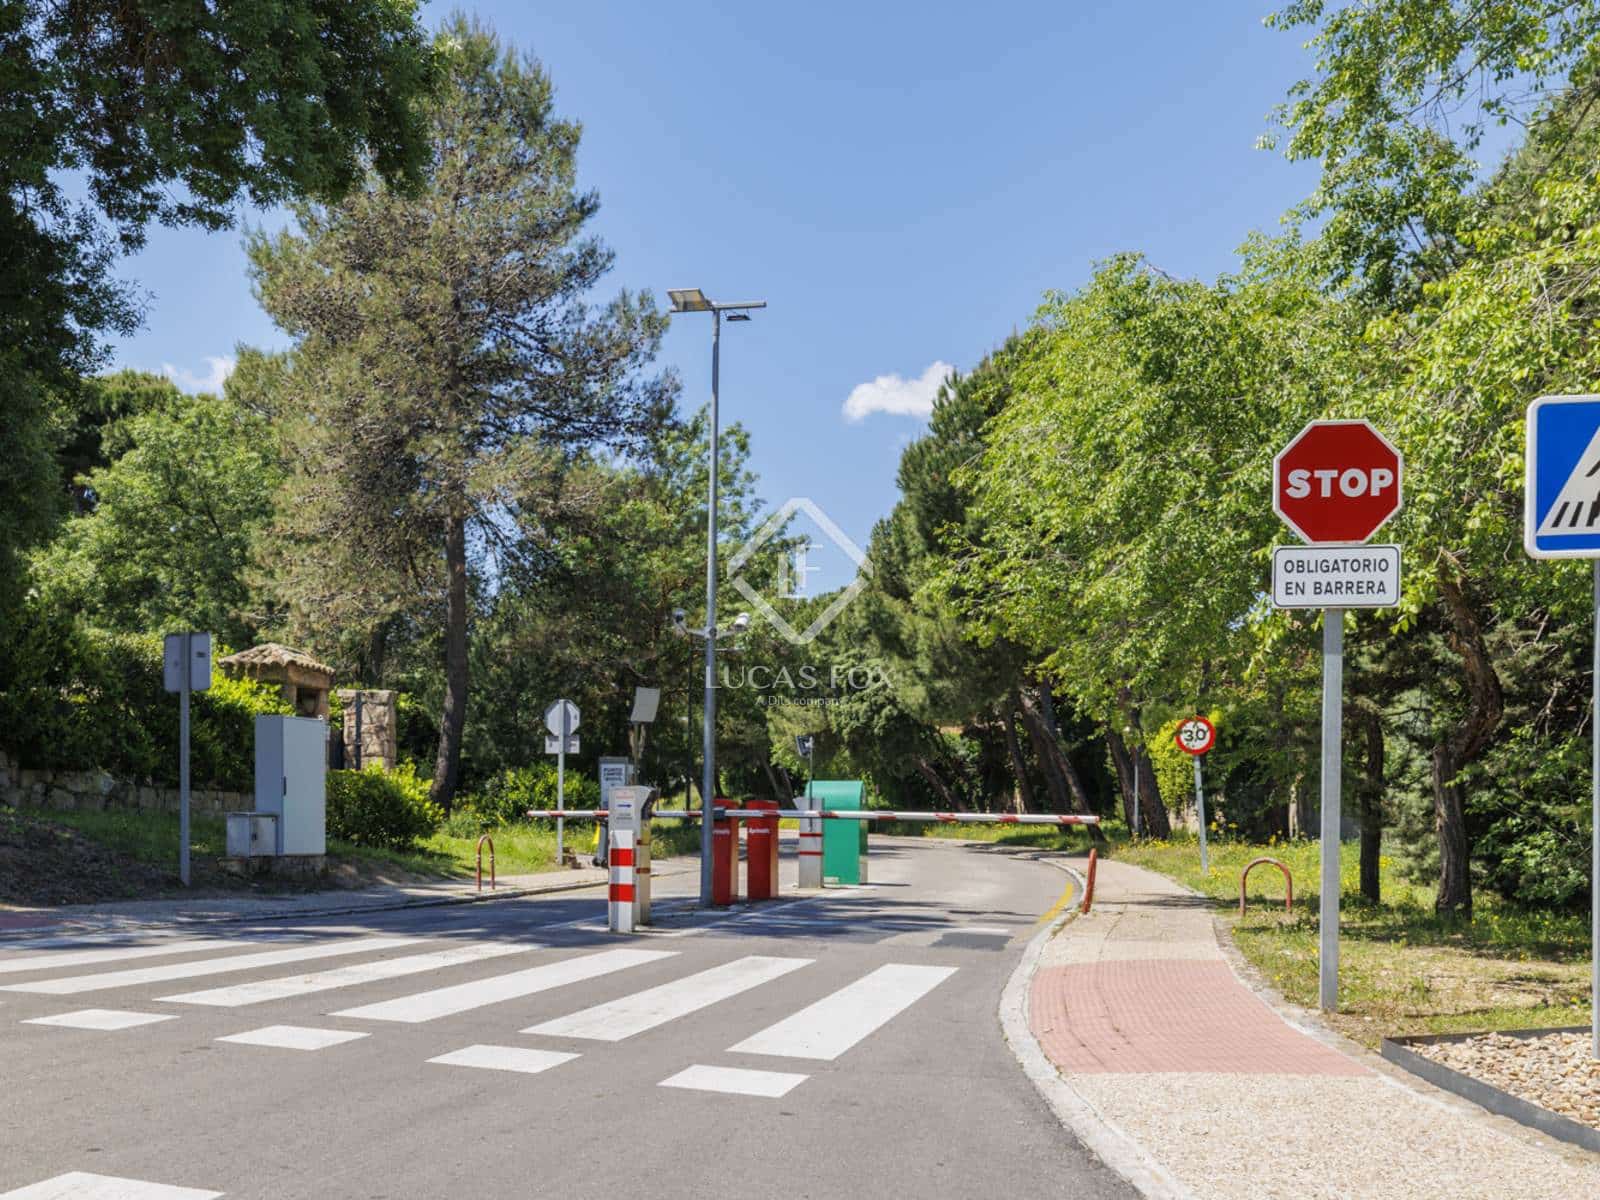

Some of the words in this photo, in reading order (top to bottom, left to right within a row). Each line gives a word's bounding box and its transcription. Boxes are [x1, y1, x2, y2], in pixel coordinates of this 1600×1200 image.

[1286, 468, 1394, 499] STOP
[1284, 559, 1390, 574] OBLIGATORIO
[1285, 581, 1306, 596] EN
[1313, 580, 1387, 595] BARRERA
[1183, 728, 1207, 742] 30
